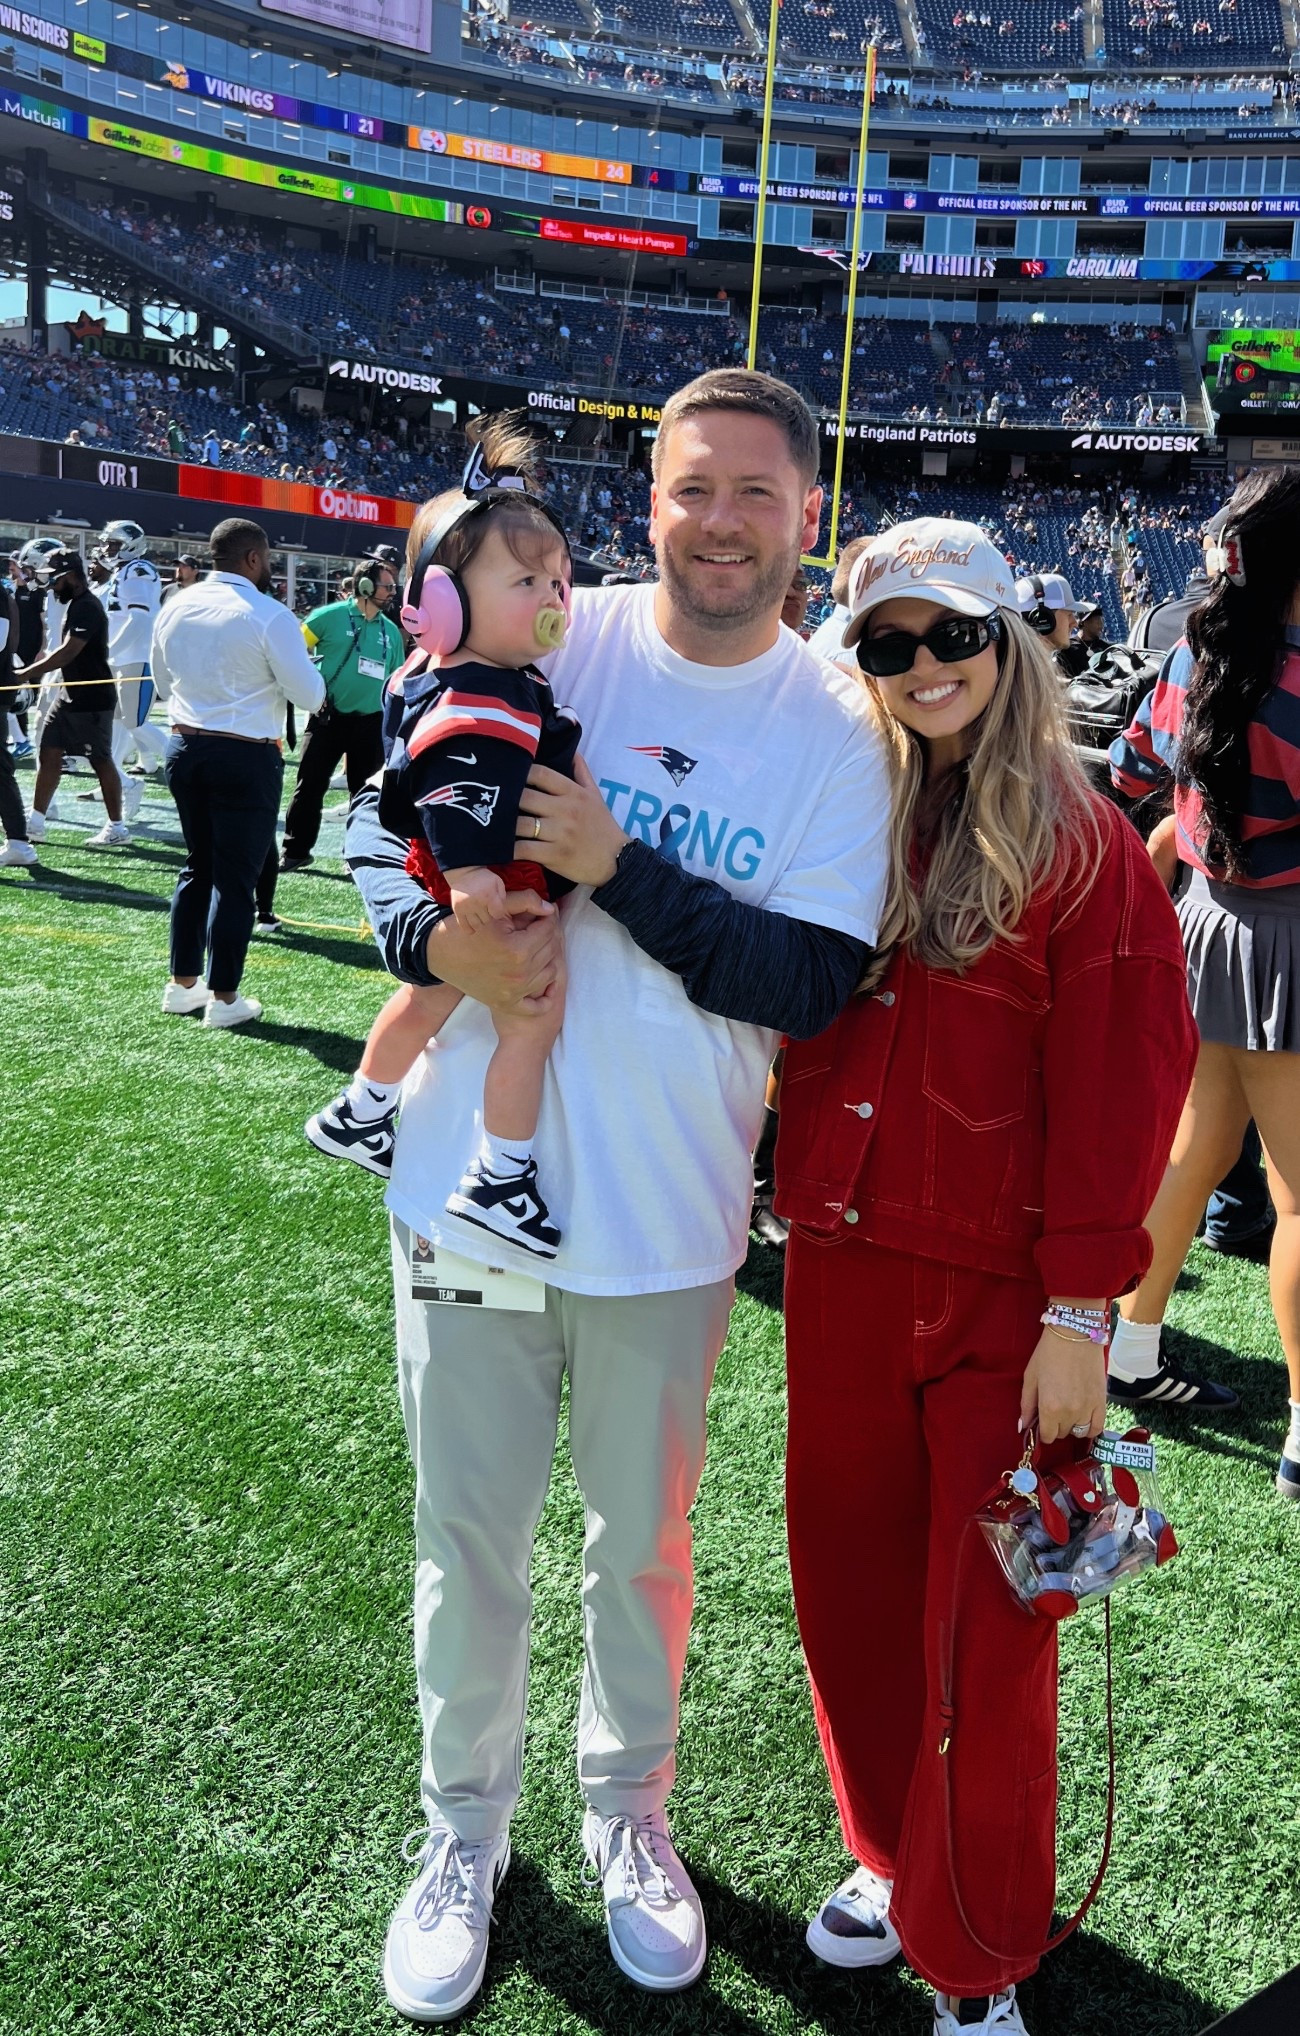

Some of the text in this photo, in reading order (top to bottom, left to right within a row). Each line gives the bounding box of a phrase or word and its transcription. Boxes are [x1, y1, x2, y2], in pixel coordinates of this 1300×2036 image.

[21, 13, 69, 49] SCORES
[75, 40, 104, 56] Gillette
[204, 75, 275, 112] VIKINGS
[5, 98, 66, 132] Mutual
[358, 118, 374, 135] 21
[463, 139, 542, 168] STEELERS
[606, 164, 624, 180] 24
[649, 171, 659, 183] 4
[699, 184, 725, 194] LIGHT
[702, 177, 722, 186] BUD
[739, 182, 884, 205] OFFIAL BEER SPONSOR OF TE NFL
[938, 197, 1088, 211] OFFICIAL BEER SPONSOR OF THE NFL
[1102, 205, 1129, 214] LIGHT
[1106, 199, 1126, 207] BUD
[1144, 201, 1300, 212] OFFICIAL BEER SPONSOR OF THE NFL
[618, 233, 644, 246] Heart
[645, 236, 675, 251] Pumps
[1066, 258, 1139, 277] CAROLINA
[351, 362, 443, 395] AUTODESK
[528, 391, 576, 412] Official
[579, 398, 625, 420] Design
[627, 405, 638, 419] &
[860, 425, 916, 442] England
[920, 427, 977, 444] Patriots
[1095, 434, 1199, 453] AUTODESK
[99, 460, 138, 489] QTR 1
[320, 489, 380, 521] Optum
[855, 536, 975, 600] New England
[438, 1289, 456, 1302] TEAM
[1132, 1446, 1149, 1454] WEEK
